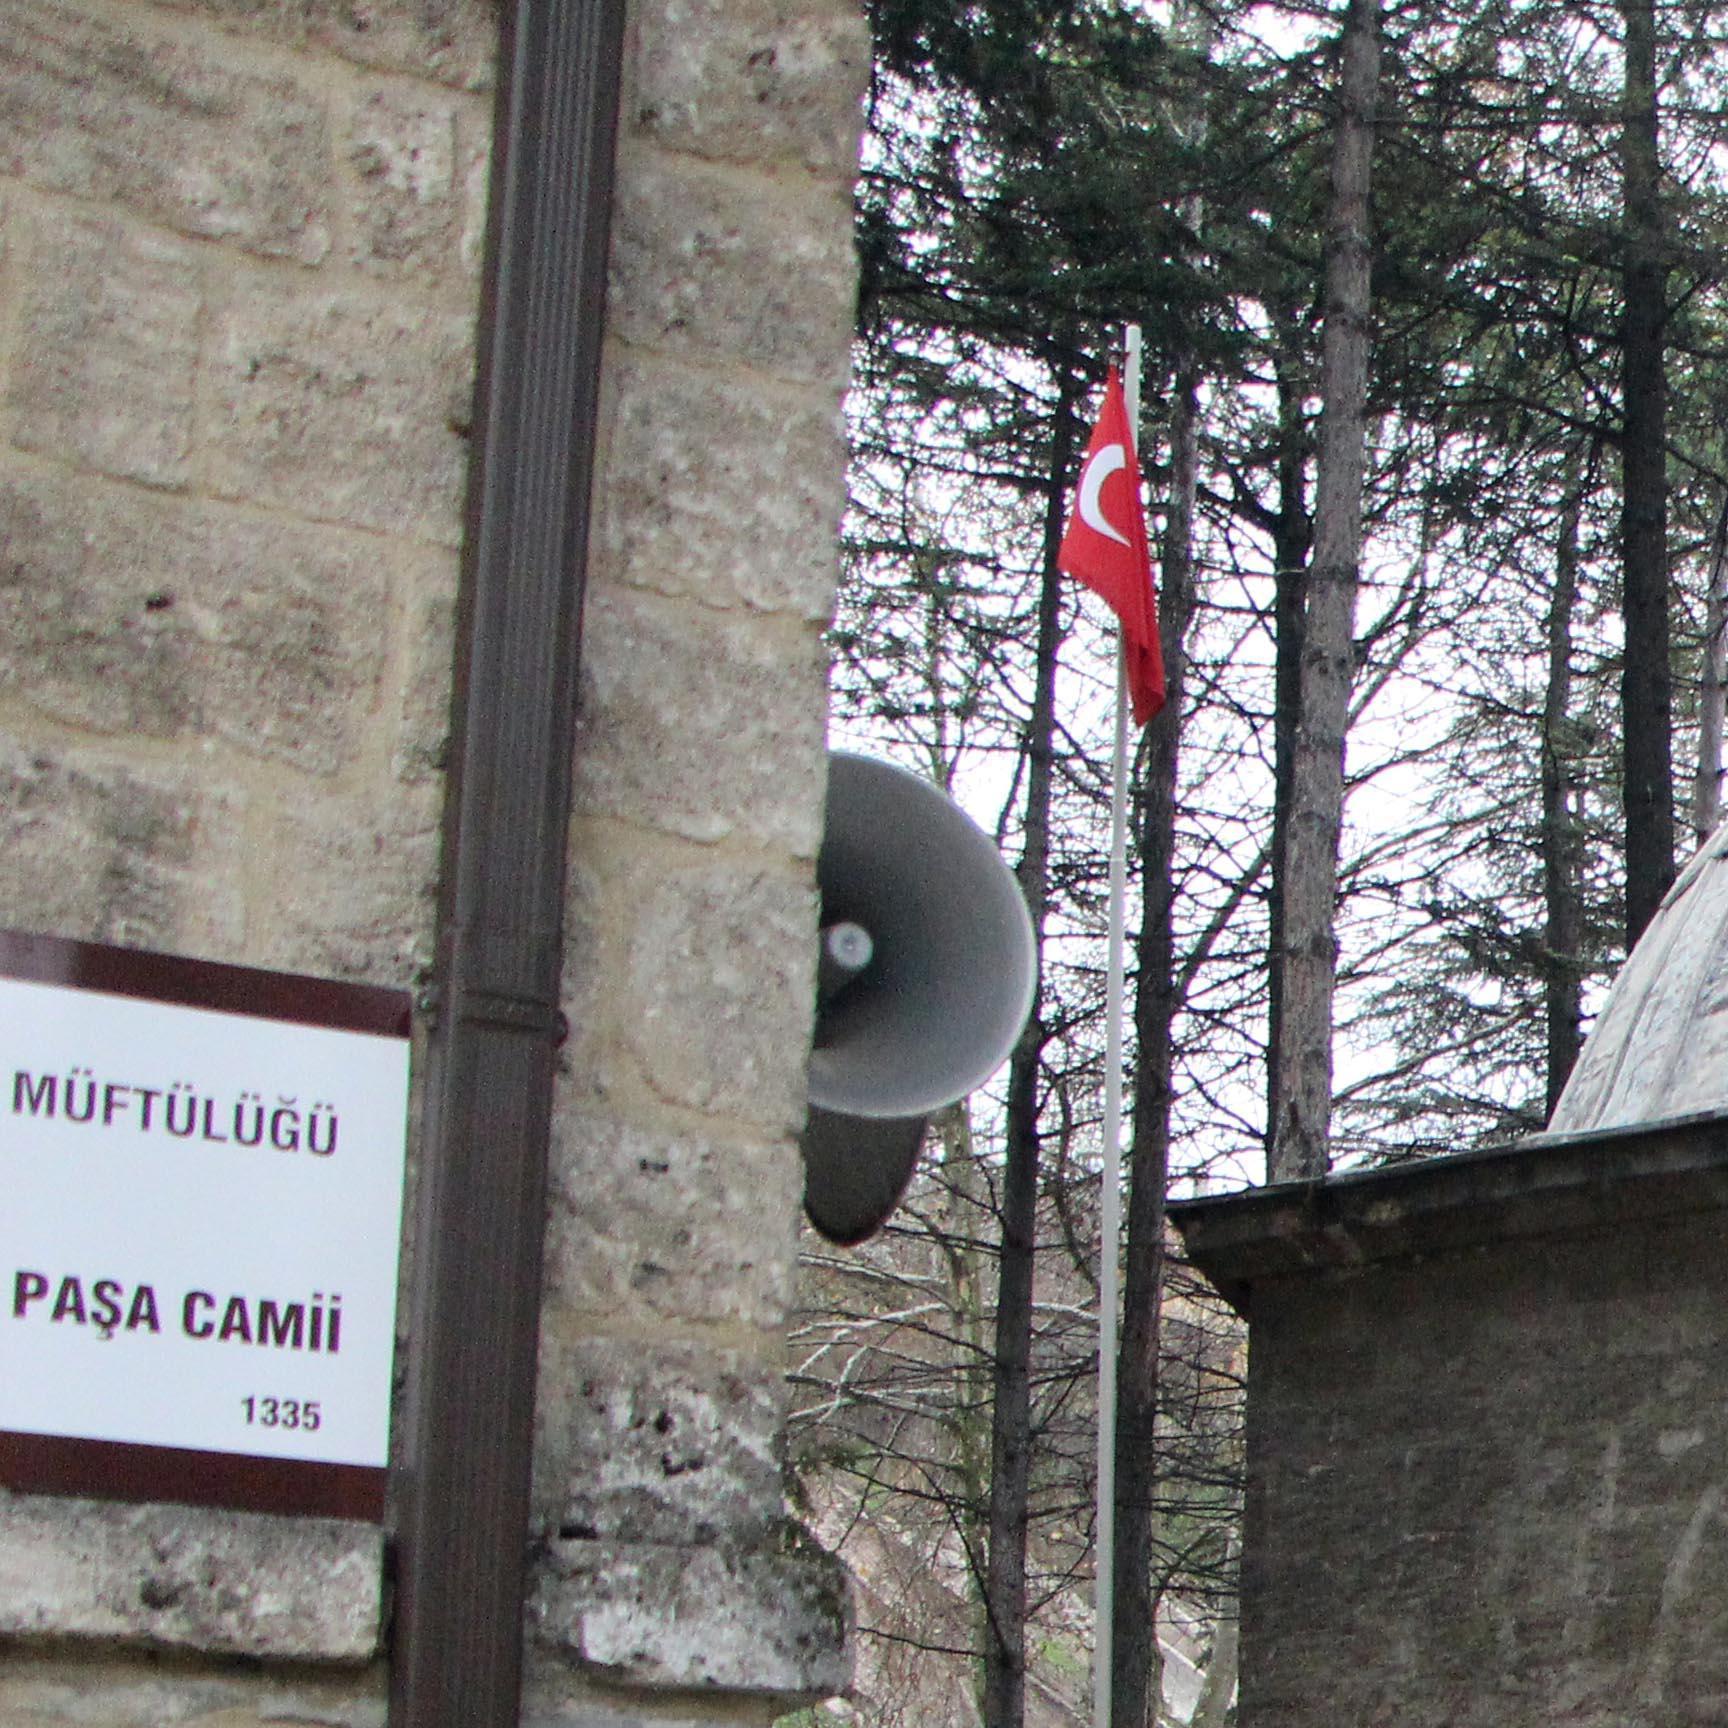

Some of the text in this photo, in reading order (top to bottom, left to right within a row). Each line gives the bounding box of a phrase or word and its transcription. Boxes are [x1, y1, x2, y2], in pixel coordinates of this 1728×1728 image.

[12, 1067, 339, 1157] MÜFTÜLÜĞÜ
[12, 1270, 343, 1354] PAŞA CAMİİ
[241, 1395, 321, 1431] 1335
